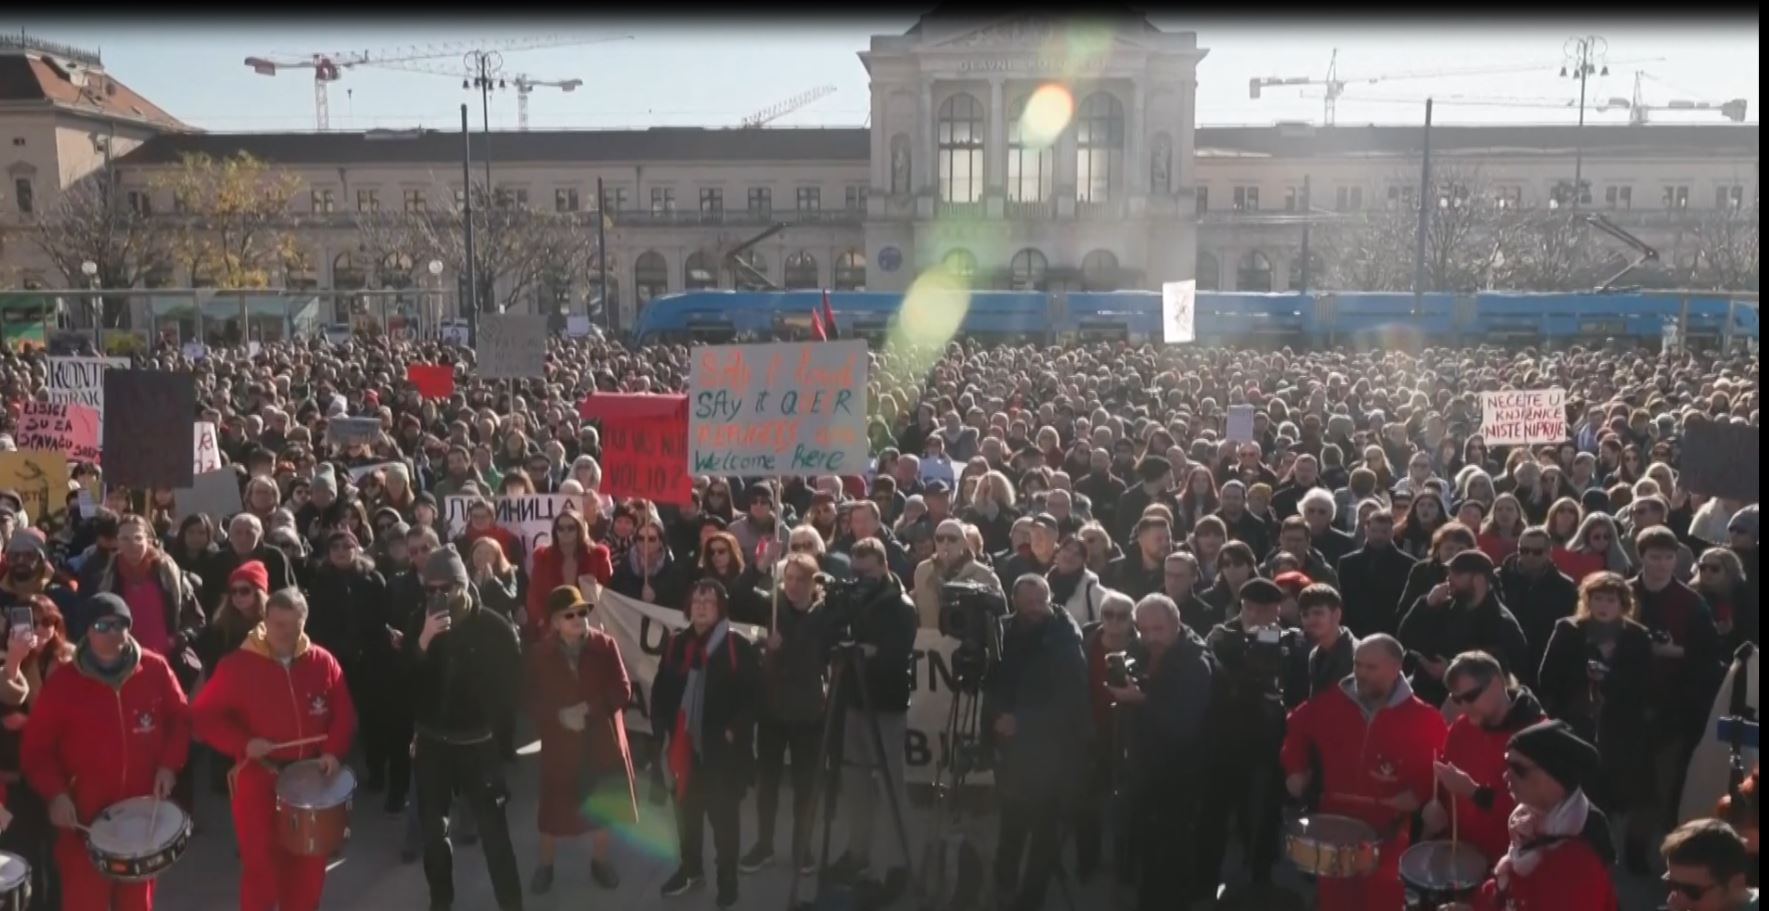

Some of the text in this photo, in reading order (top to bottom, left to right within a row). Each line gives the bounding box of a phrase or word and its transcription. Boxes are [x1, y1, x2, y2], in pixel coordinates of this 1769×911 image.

[51, 361, 110, 388] KONT
[1549, 394, 1560, 406] U
[25, 418, 49, 432] SU
[446, 497, 577, 522] ЛАИНИЦА
